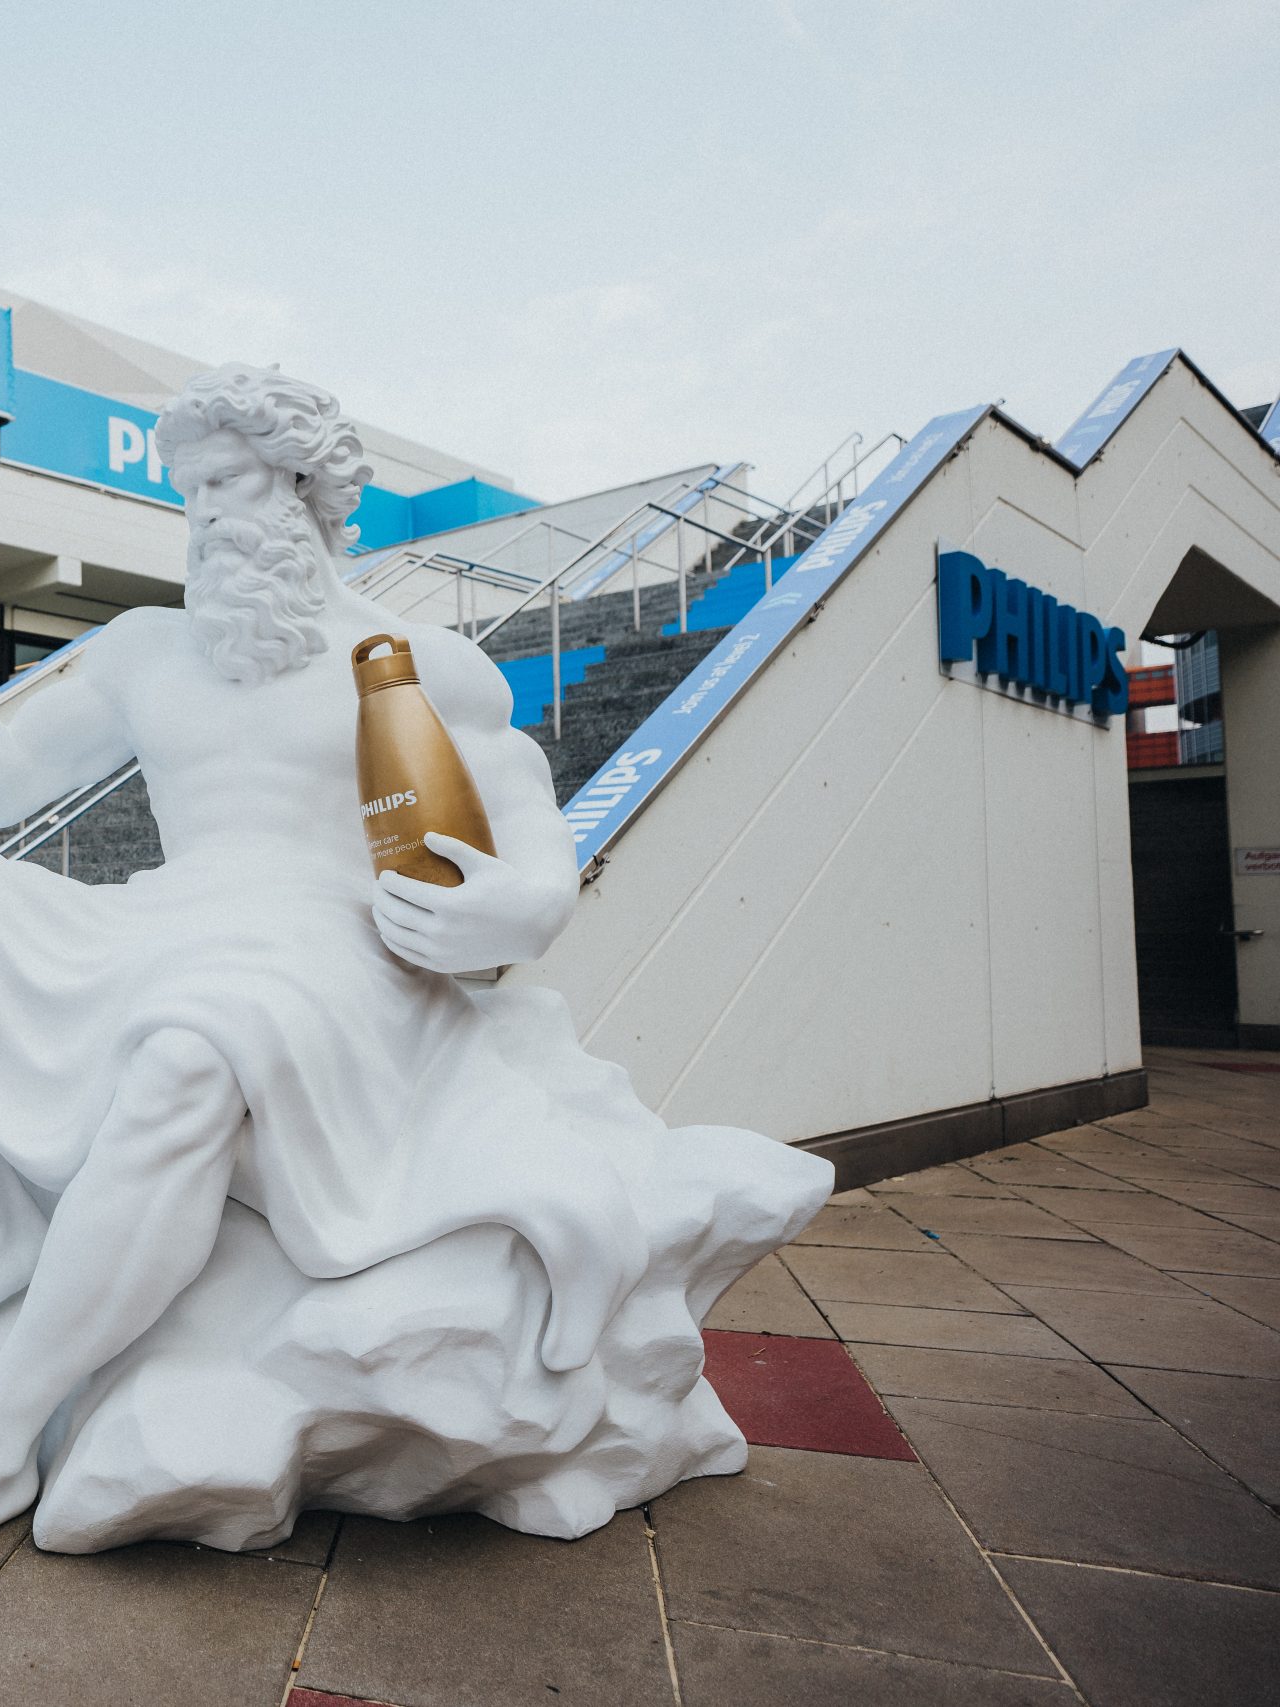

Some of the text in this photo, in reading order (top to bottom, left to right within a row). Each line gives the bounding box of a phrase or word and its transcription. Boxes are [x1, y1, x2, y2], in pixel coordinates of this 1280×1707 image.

[796, 499, 888, 572] PHILIPS
[938, 550, 1130, 715] PHILIPS
[361, 789, 418, 820] PHILIPS
[376, 847, 394, 858] more
[394, 837, 426, 856] people
[383, 834, 400, 845] care
